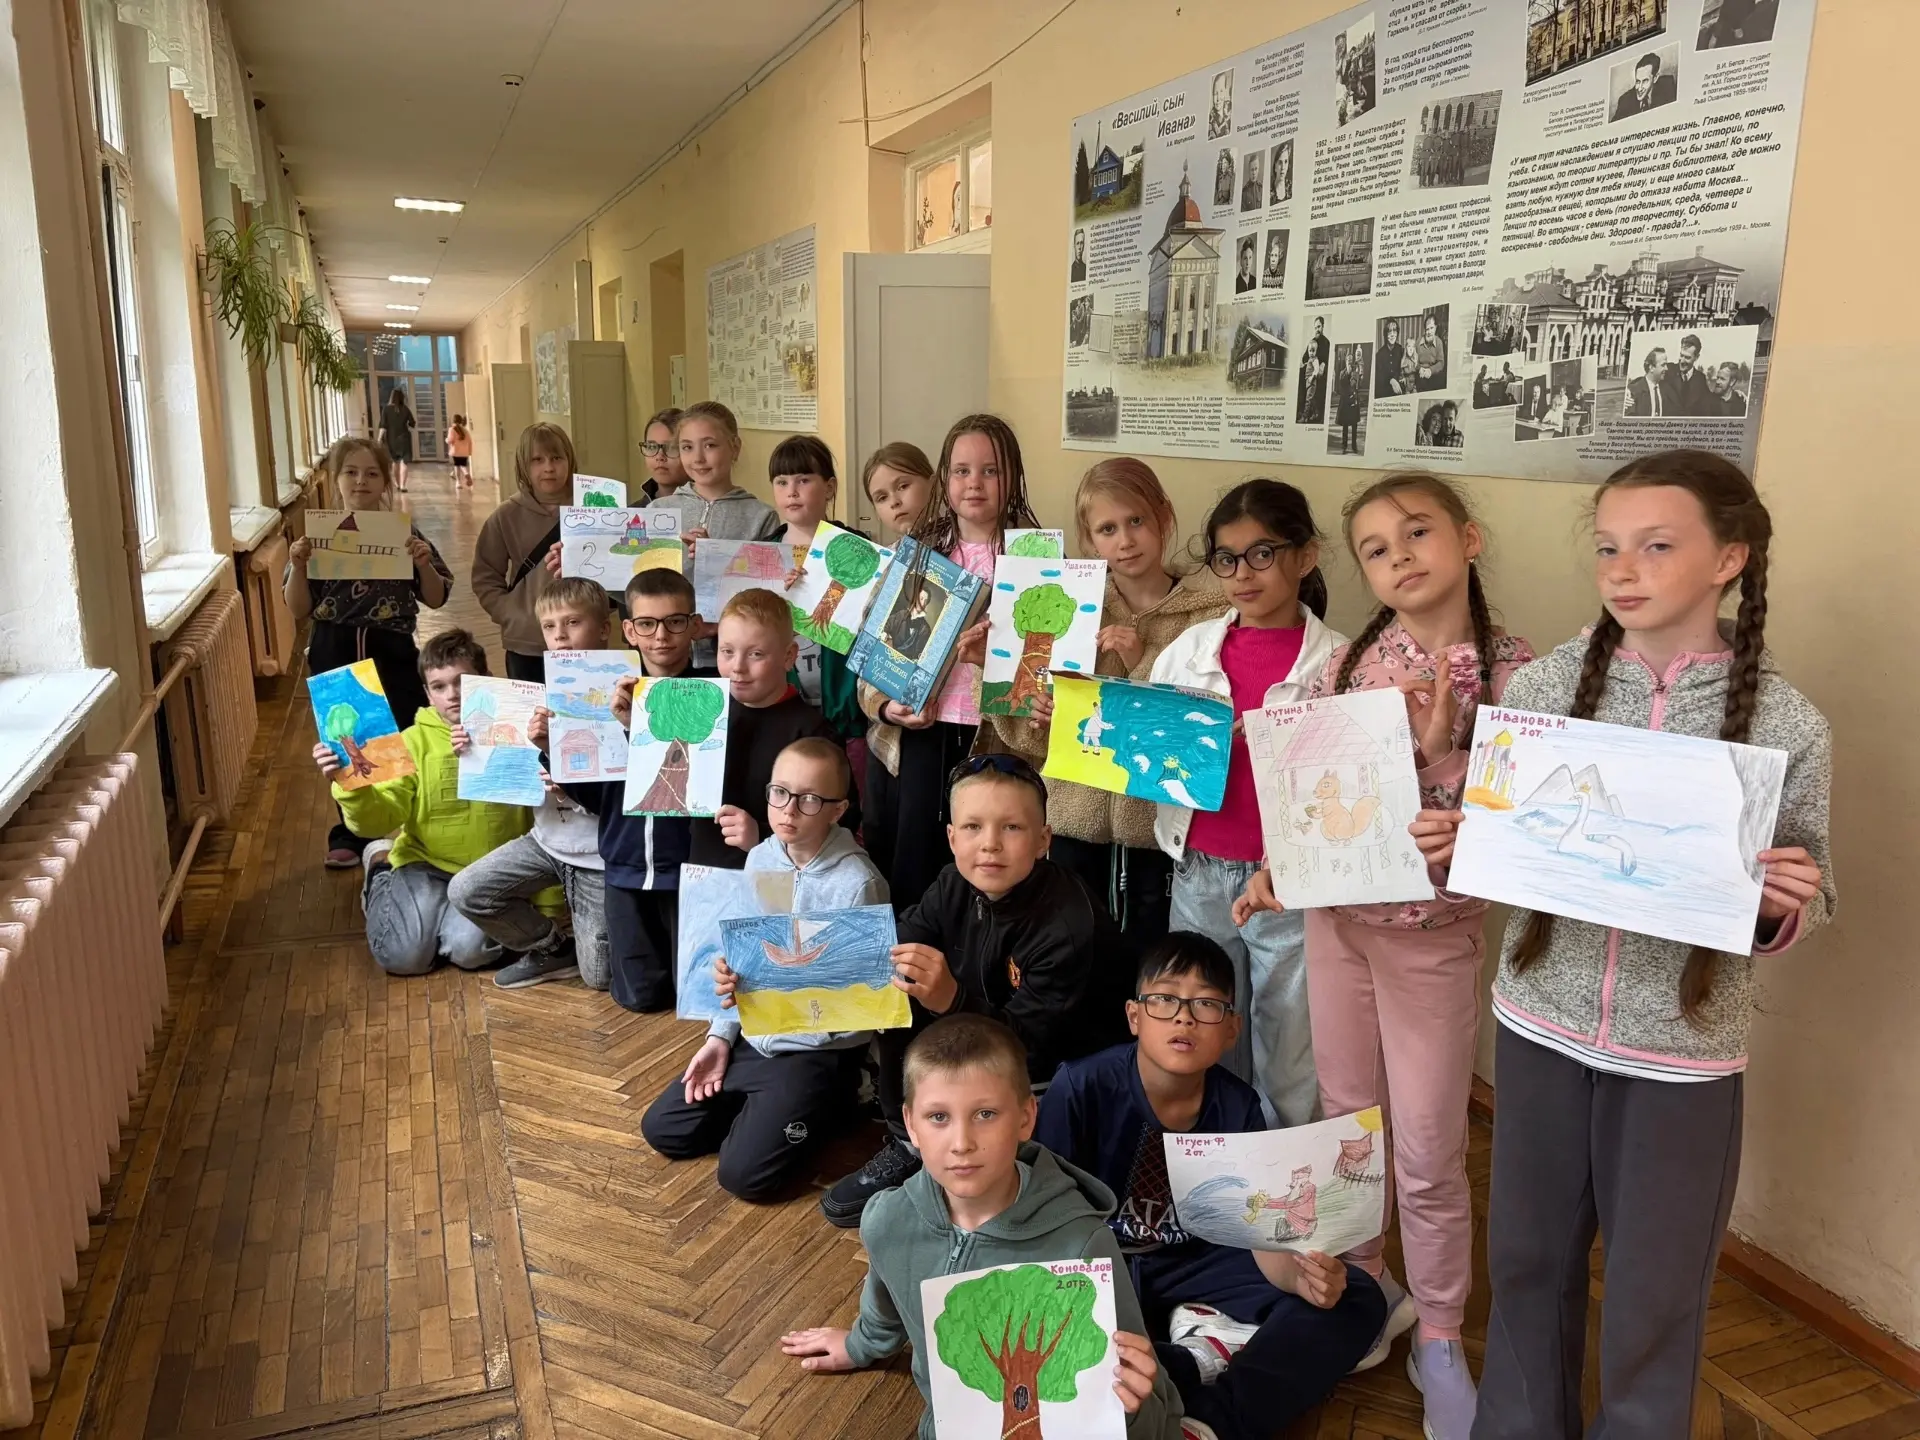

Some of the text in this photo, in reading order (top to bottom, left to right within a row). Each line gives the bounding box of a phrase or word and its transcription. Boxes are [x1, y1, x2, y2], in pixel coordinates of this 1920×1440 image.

[1112, 93, 1185, 129] «Василий, сын
[1158, 114, 1196, 138] Ивана»
[1508, 167, 1529, 178] учеба.
[1537, 162, 1559, 171] каким
[1559, 151, 1614, 166] наслаждением
[1622, 143, 1655, 154] слушаю
[1656, 136, 1687, 147] лекции
[1701, 125, 1744, 138] истории,
[1510, 105, 1785, 165] «У меня тут началась весьма интересная жизнь. Главное, конечно,
[1507, 174, 1555, 187] языкознанию,
[1567, 166, 1596, 176] теории
[1597, 155, 1651, 170] литературы
[1675, 147, 1688, 156] Ты
[1688, 144, 1703, 153] бы
[1704, 138, 1729, 150] знал!
[1729, 137, 1742, 146] Ко
[1743, 133, 1773, 143] всему
[1507, 190, 1529, 198] этому
[1549, 182, 1569, 191] ждут
[1570, 178, 1594, 187] сотня
[1595, 172, 1624, 183] музеев,
[1626, 164, 1671, 177] Ленинская
[1671, 154, 1728, 169] библиотека,
[1730, 150, 1747, 159] где
[1748, 144, 1781, 155] можно
[1503, 206, 1557, 221] разнообразных
[1558, 200, 1582, 211] вещей,
[1584, 195, 1627, 206] которыми
[1640, 187, 1671, 197] отказа
[1672, 182, 1706, 192] набита
[1707, 176, 1748, 186] Москва...
[1505, 201, 1526, 209] взять
[1527, 196, 1553, 205] любую,
[1554, 191, 1584, 201] нужную
[1584, 188, 1600, 196] для
[1600, 183, 1622, 192] тебя
[1623, 180, 1647, 189] книгу,
[1656, 175, 1675, 183] еще
[1675, 170, 1704, 180] много
[1704, 164, 1735, 174] самых
[1502, 230, 1535, 241] пятница).
[1548, 225, 1580, 234] вторник
[1585, 219, 1618, 229] семинар
[1631, 209, 1686, 222] творчеству.
[1687, 202, 1730, 214] Суббота
[1503, 222, 1527, 230] Лекции
[1538, 216, 1563, 225] восемь
[1594, 209, 1613, 218] день
[1614, 200, 1672, 215] (понедельник,
[1674, 195, 1702, 205] среда,
[1706, 188, 1745, 199] четверг
[1501, 218, 1700, 252] воскресенье свободные дни. Здорово! правда?...».
[1064, 560, 1097, 570] Ушакова
[1265, 705, 1302, 719] Кутина
[1276, 717, 1282, 726] 2
[1490, 710, 1568, 730] Иванова М.
[1519, 727, 1527, 736] 2
[1176, 1136, 1210, 1149] Нгуен
[1051, 1263, 1112, 1274] Коновалов
[1100, 1273, 1110, 1283] С.
